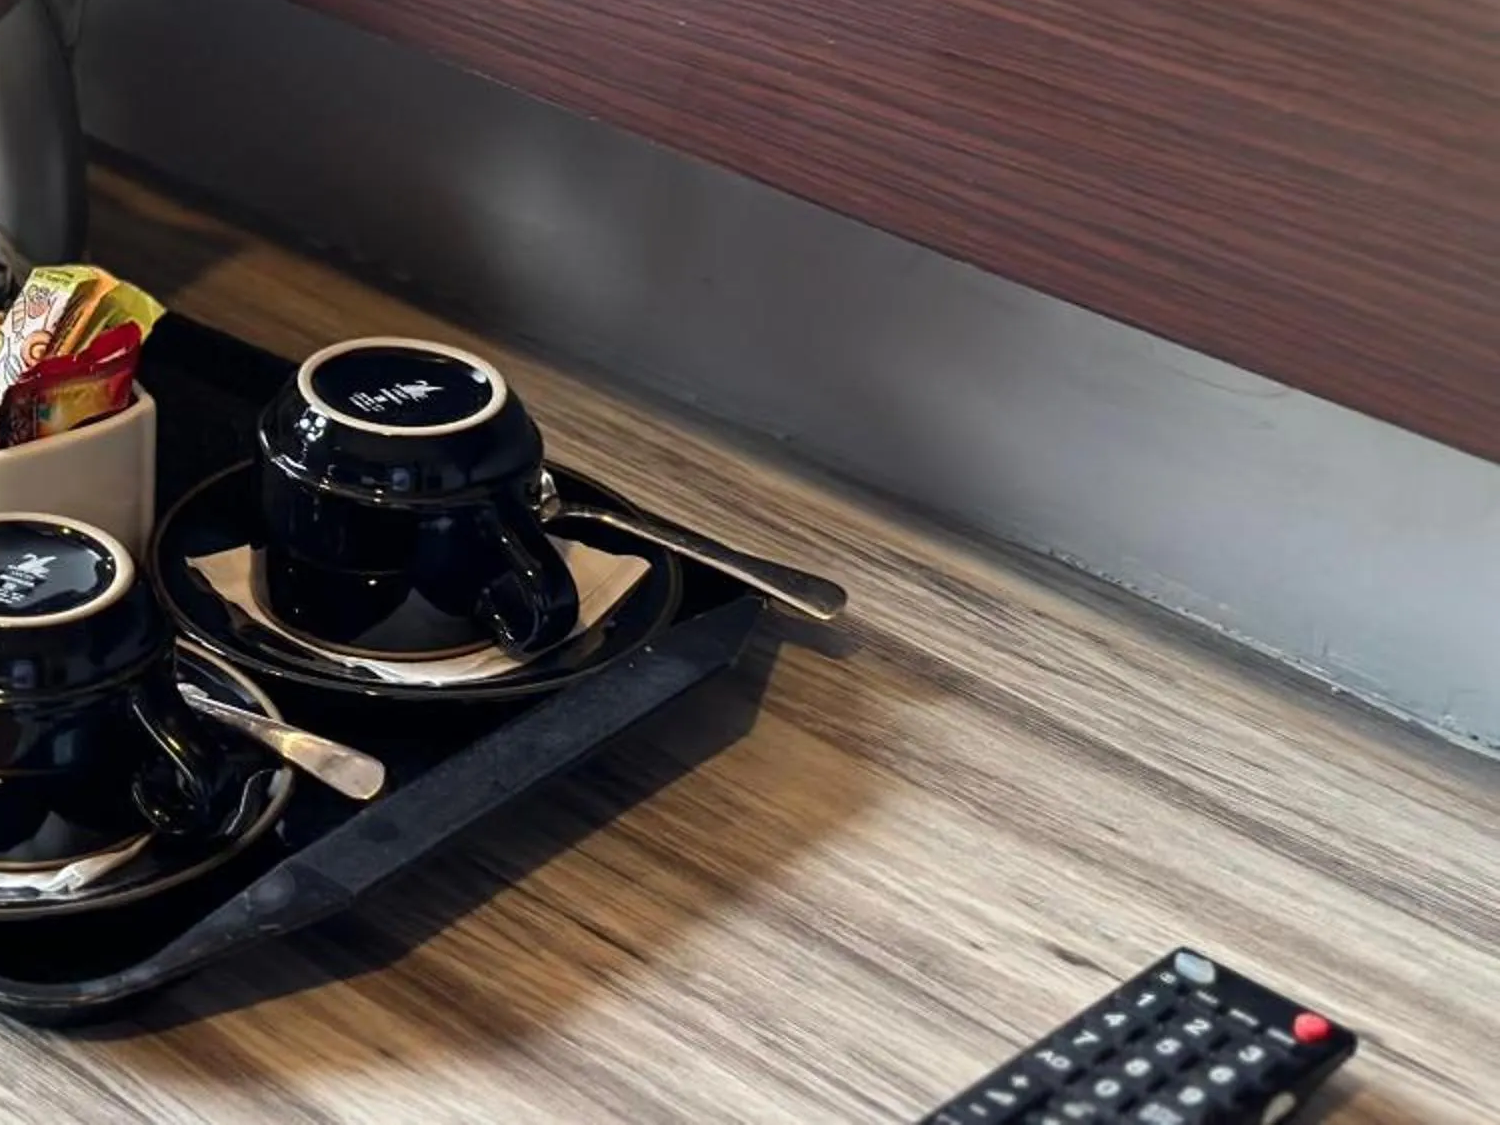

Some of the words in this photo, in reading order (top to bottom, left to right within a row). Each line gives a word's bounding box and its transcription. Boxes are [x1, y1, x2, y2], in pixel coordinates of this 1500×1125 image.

[1104, 1013, 1128, 1027] 4
[1137, 992, 1156, 1007] 1
[1183, 1018, 1212, 1036] 2
[1238, 1045, 1264, 1063] 3
[1073, 1030, 1099, 1046] 7
